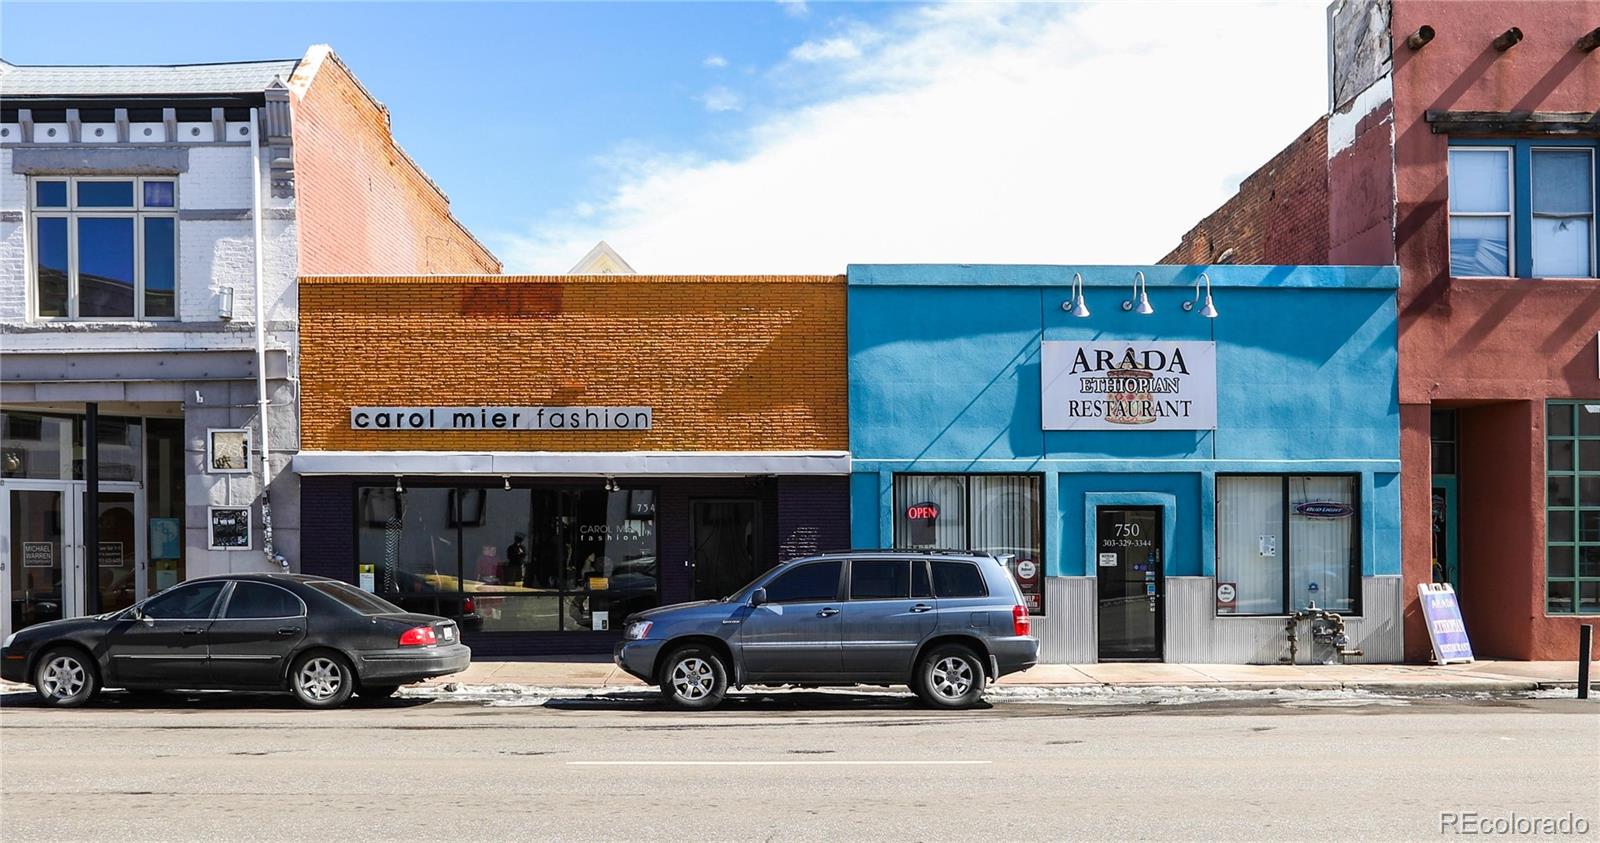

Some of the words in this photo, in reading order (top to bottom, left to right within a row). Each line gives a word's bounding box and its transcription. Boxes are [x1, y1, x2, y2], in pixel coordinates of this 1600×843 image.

[1069, 347, 1190, 375] ARADA
[1080, 377, 1180, 394] ETHIOPIAN
[1069, 400, 1192, 417] RESTAURANT
[354, 408, 434, 428] carol
[453, 408, 521, 428] mier
[537, 408, 648, 428] fashion
[908, 506, 938, 520] OPEN
[580, 524, 612, 534] CAROL
[1114, 523, 1140, 537] 750
[580, 534, 638, 542] fashion
[1102, 539, 1152, 547] 303-329-3344
